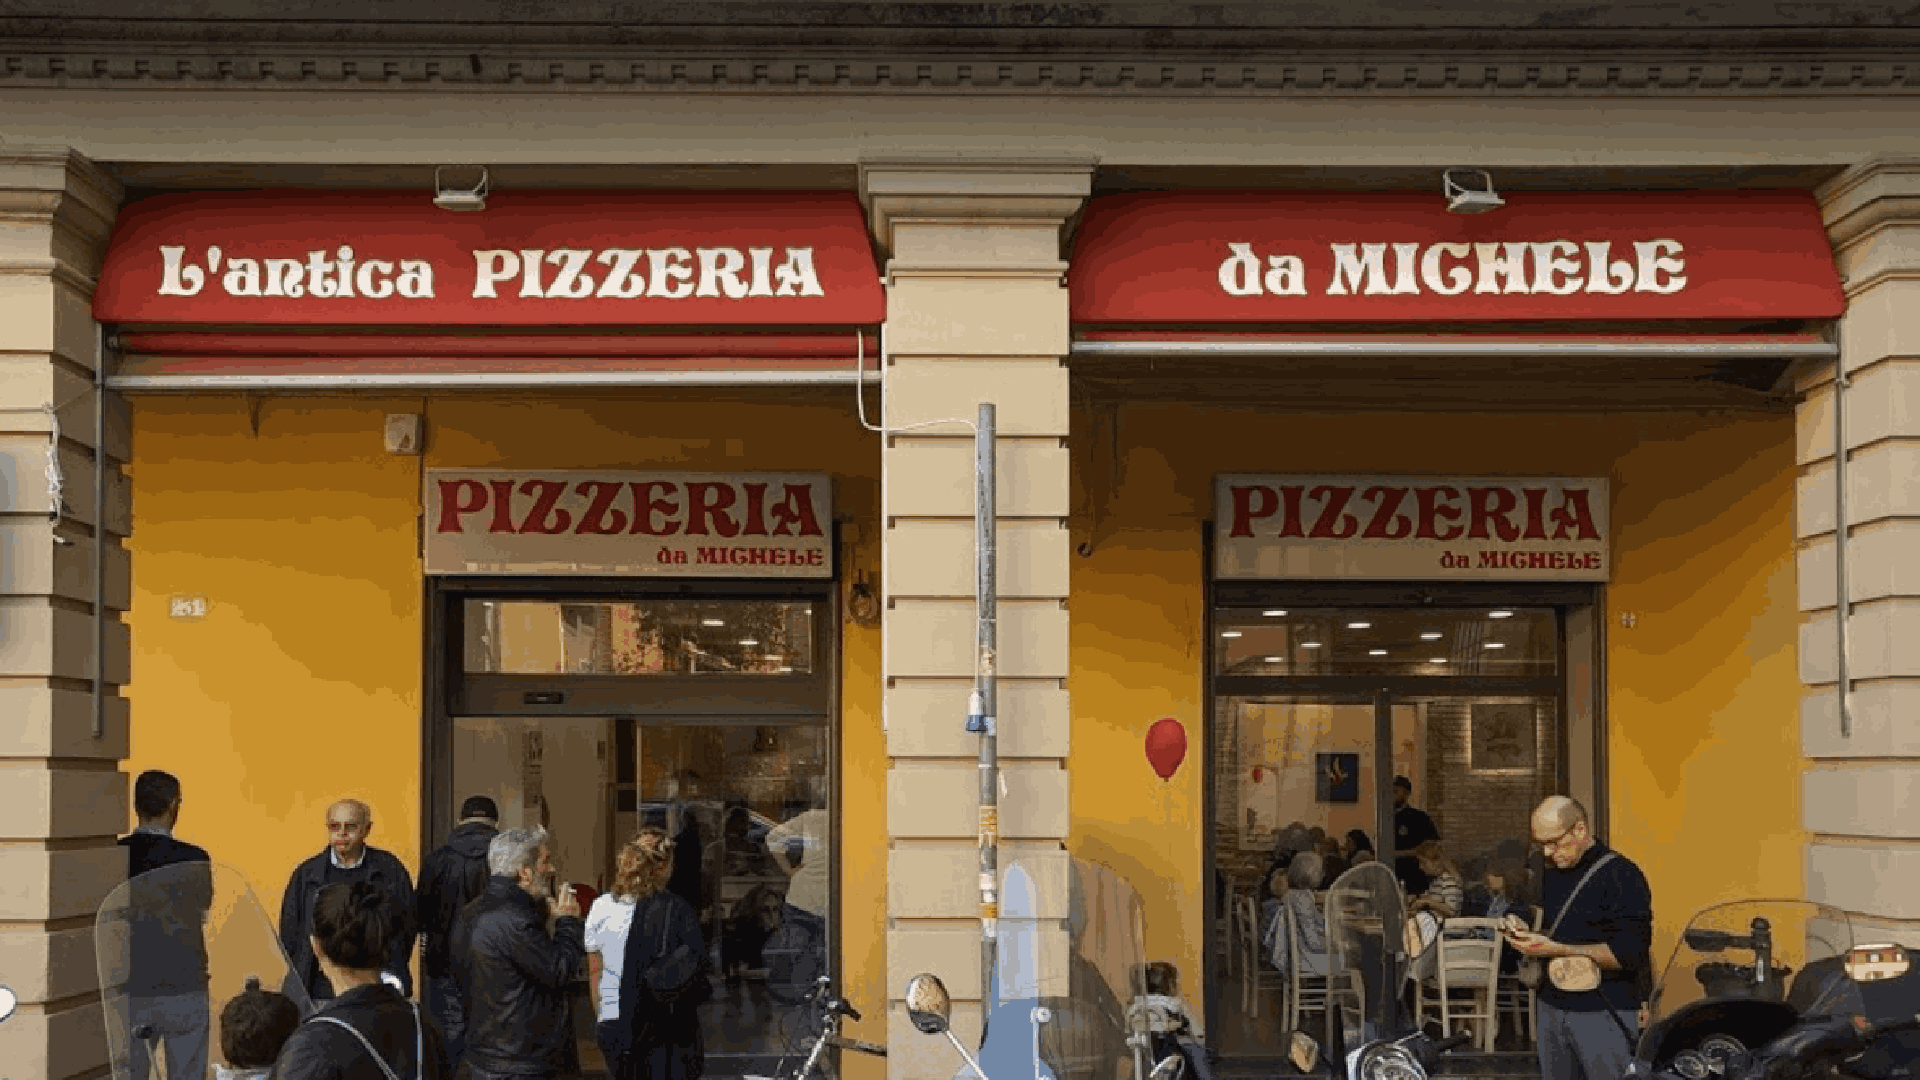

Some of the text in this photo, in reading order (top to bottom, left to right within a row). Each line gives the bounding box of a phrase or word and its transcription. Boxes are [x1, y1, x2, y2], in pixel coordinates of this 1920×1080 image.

[157, 245, 825, 299] L'antica PIZZERIA
[1218, 240, 1688, 296] da MICHELE
[437, 479, 824, 537] PIZZERIA
[1229, 484, 1602, 542] PIZZERIA
[657, 545, 823, 566] da MICHELE
[1440, 551, 1601, 569] da MICHELE
